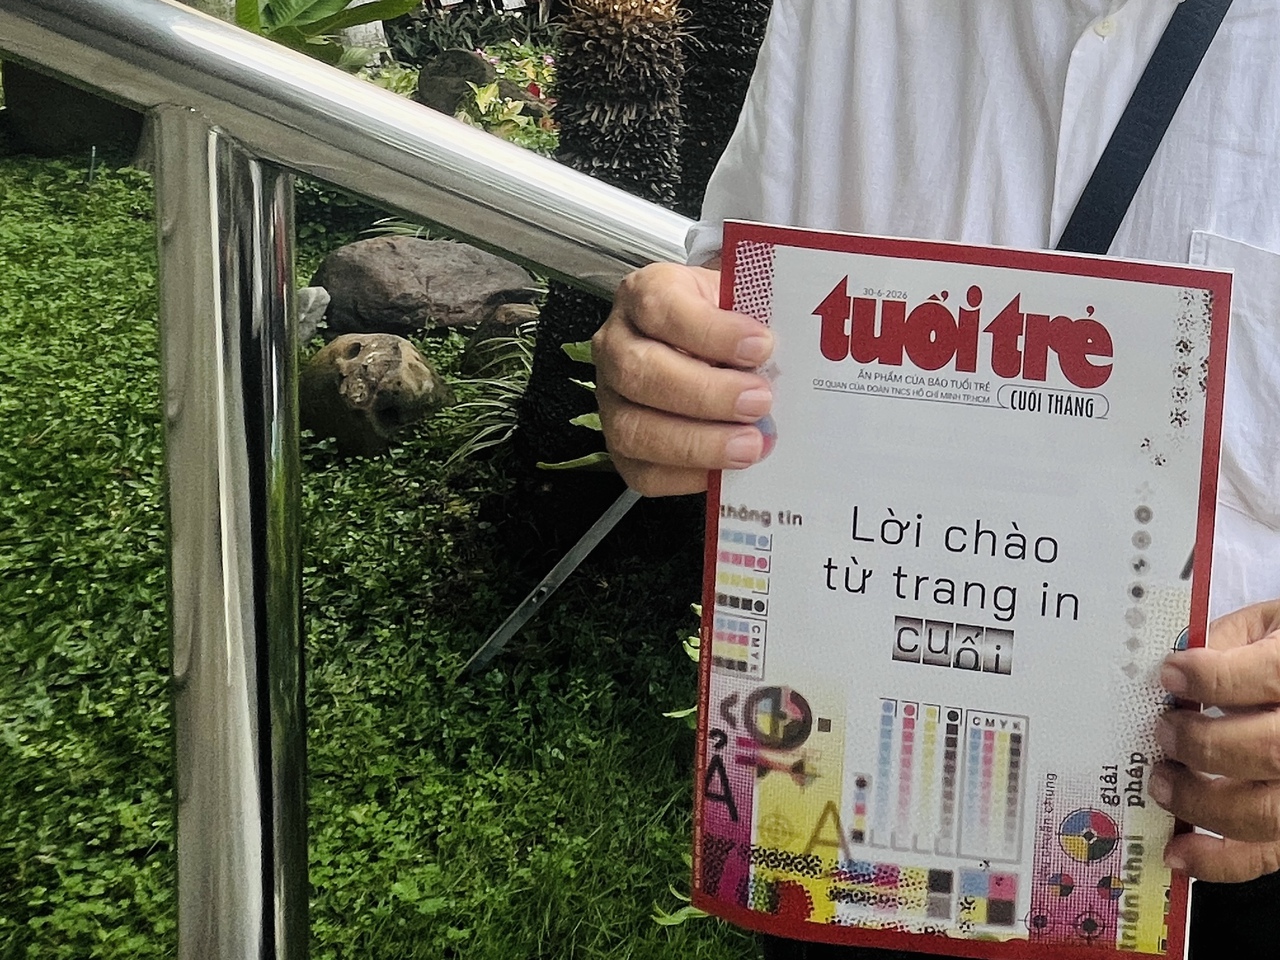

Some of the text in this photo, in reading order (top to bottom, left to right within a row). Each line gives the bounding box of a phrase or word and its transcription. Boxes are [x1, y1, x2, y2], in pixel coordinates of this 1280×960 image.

[863, 287, 908, 300] 30-6-2026
[811, 275, 1113, 389] tuổi trẻ
[813, 378, 990, 403] CƠ QUAN CỦA ĐOÀN TNCS HỒ CHÍ MINH TP.HCM
[905, 374, 926, 386] CỦA
[928, 377, 949, 387] BÁO
[950, 378, 971, 390] TUỔI
[973, 381, 990, 392] TRẺ
[1011, 389, 1094, 418] CUỐI THÁNG
[778, 510, 803, 526] tin
[850, 505, 1059, 564] Lời chào
[823, 556, 1081, 622] từ trang in
[896, 625, 1003, 675] cuối
[1043, 773, 1058, 814] chung
[1101, 764, 1119, 806] giải
[1125, 752, 1144, 809] pháp
